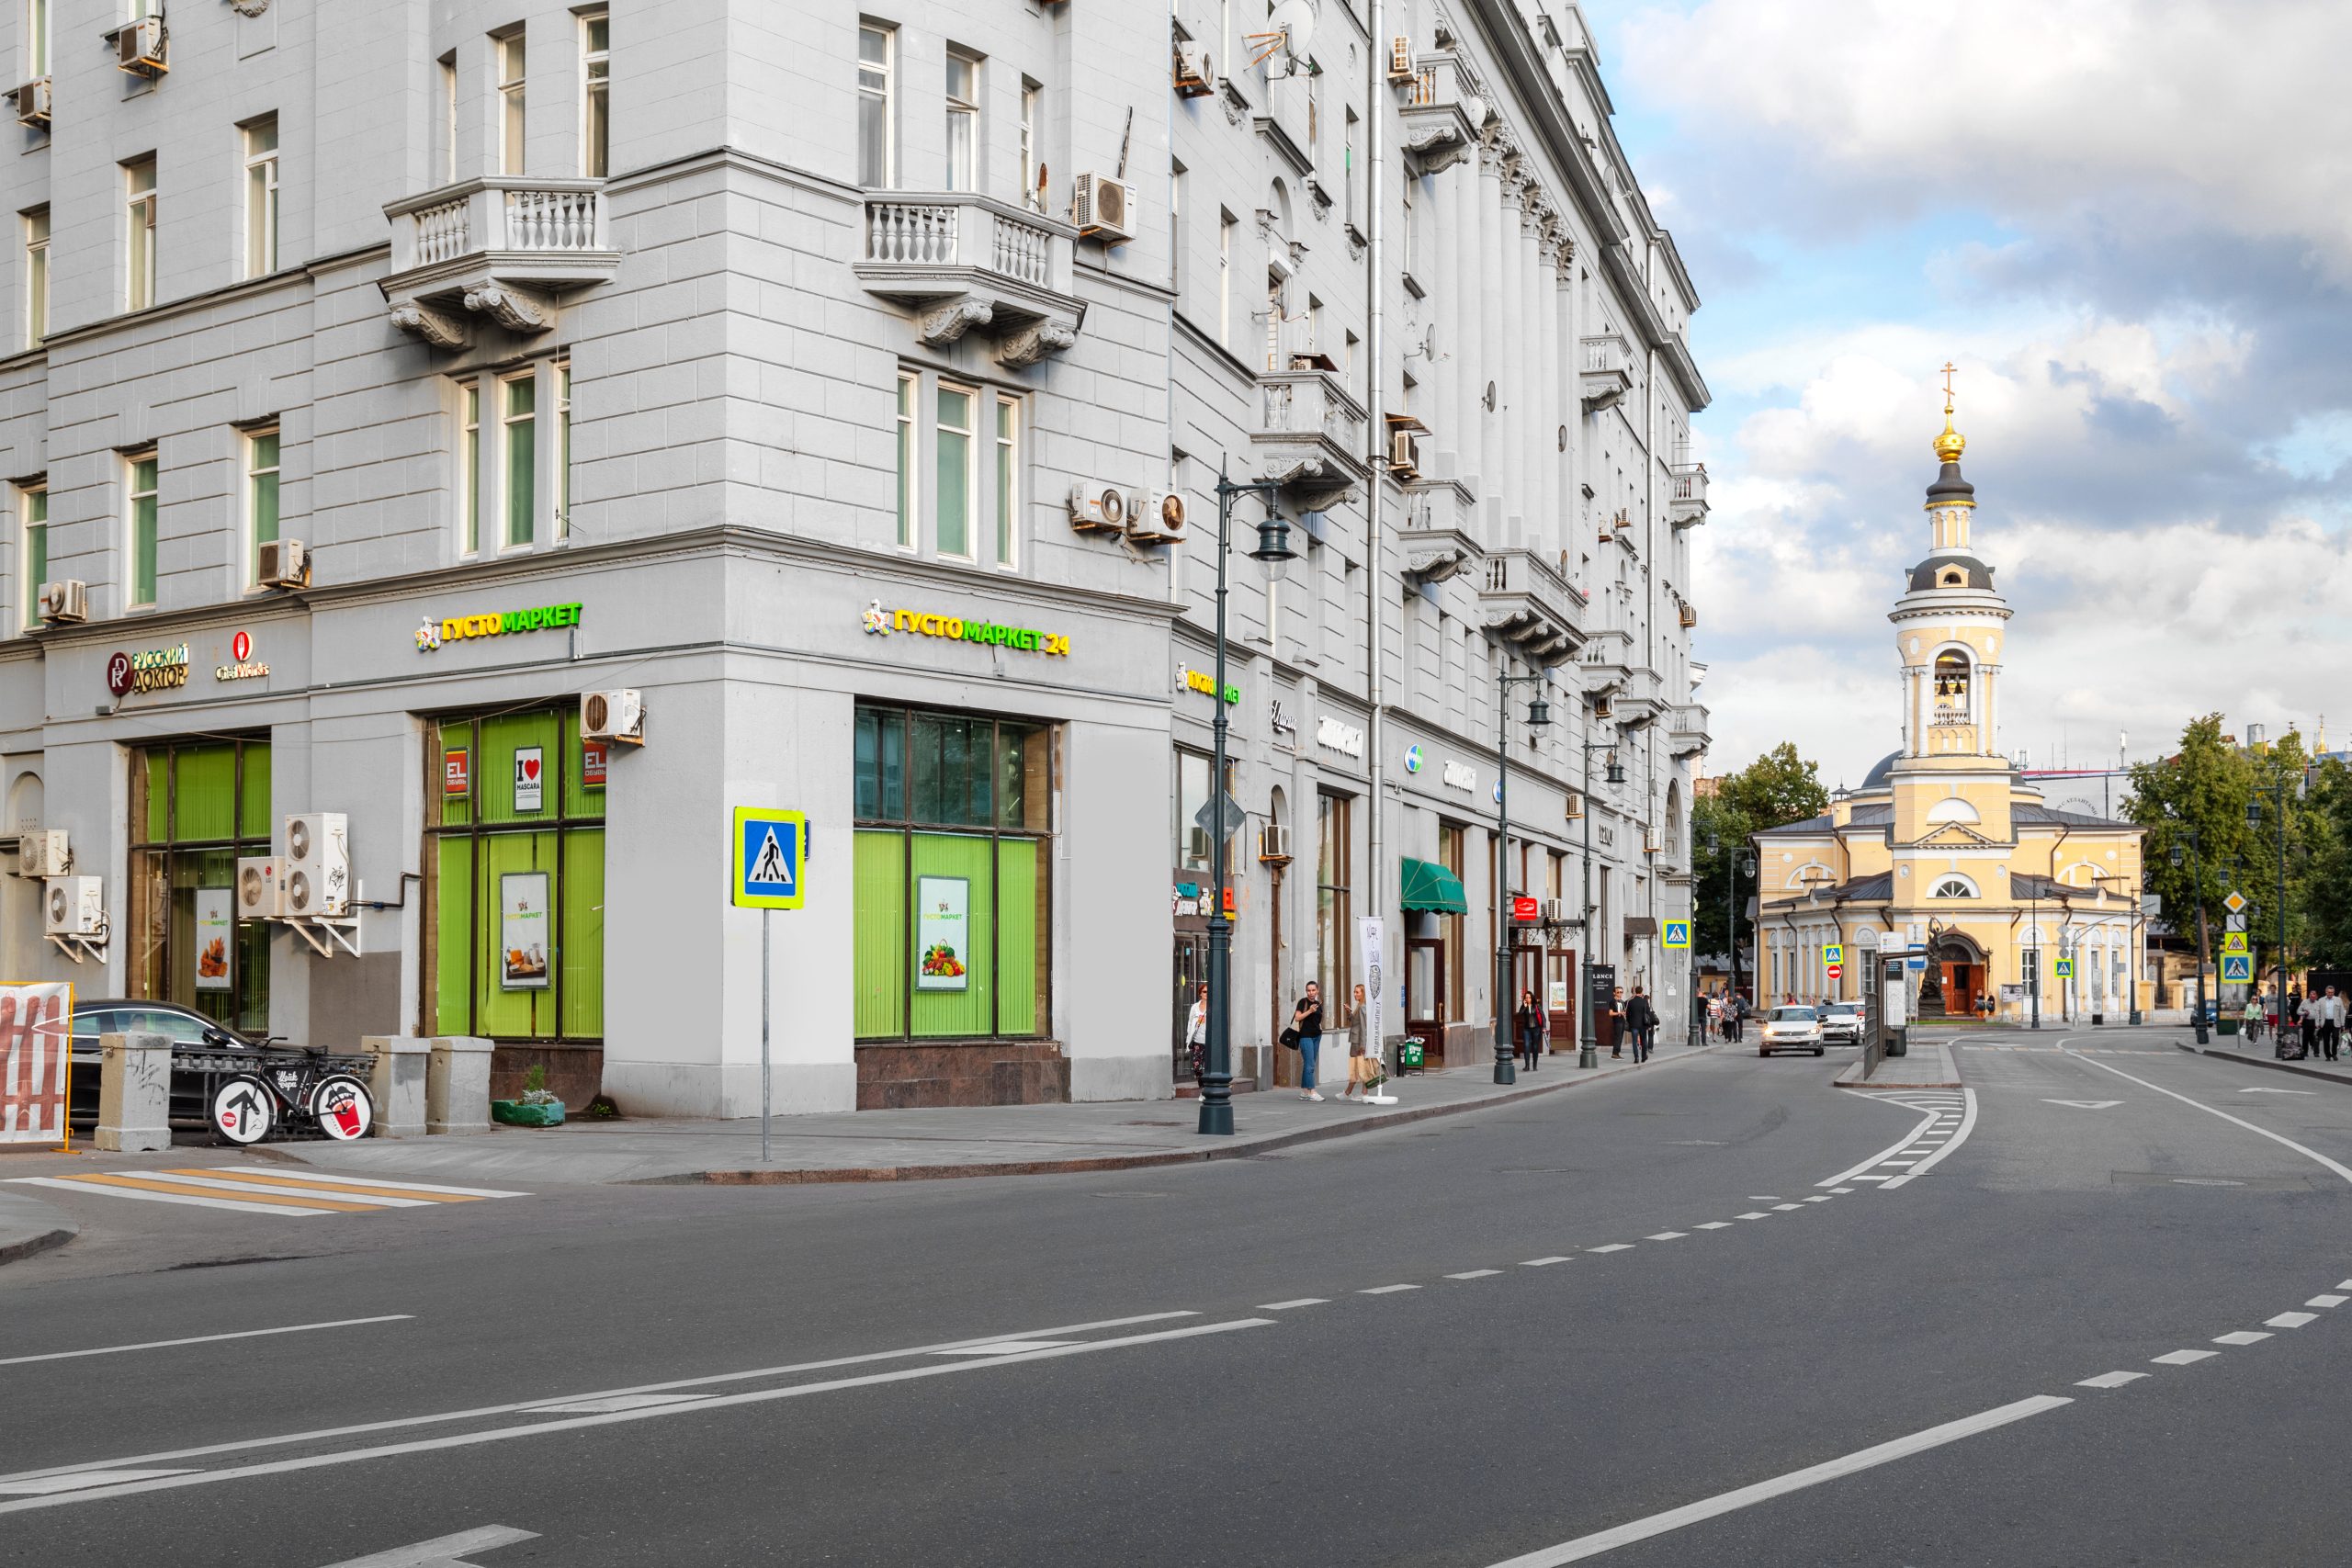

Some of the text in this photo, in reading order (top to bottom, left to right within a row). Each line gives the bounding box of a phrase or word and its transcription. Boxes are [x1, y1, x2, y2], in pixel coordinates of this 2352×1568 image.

[442, 603, 582, 640] ГУСТОМАРКЕТ
[894, 609, 1070, 655] ГУСТОМАРКЕТ 24
[132, 644, 188, 671] РУССКИЙ
[131, 666, 188, 694] ДОКТОР
[447, 761, 467, 779] EL
[585, 751, 606, 769] EL
[516, 783, 540, 791] MASCARA
